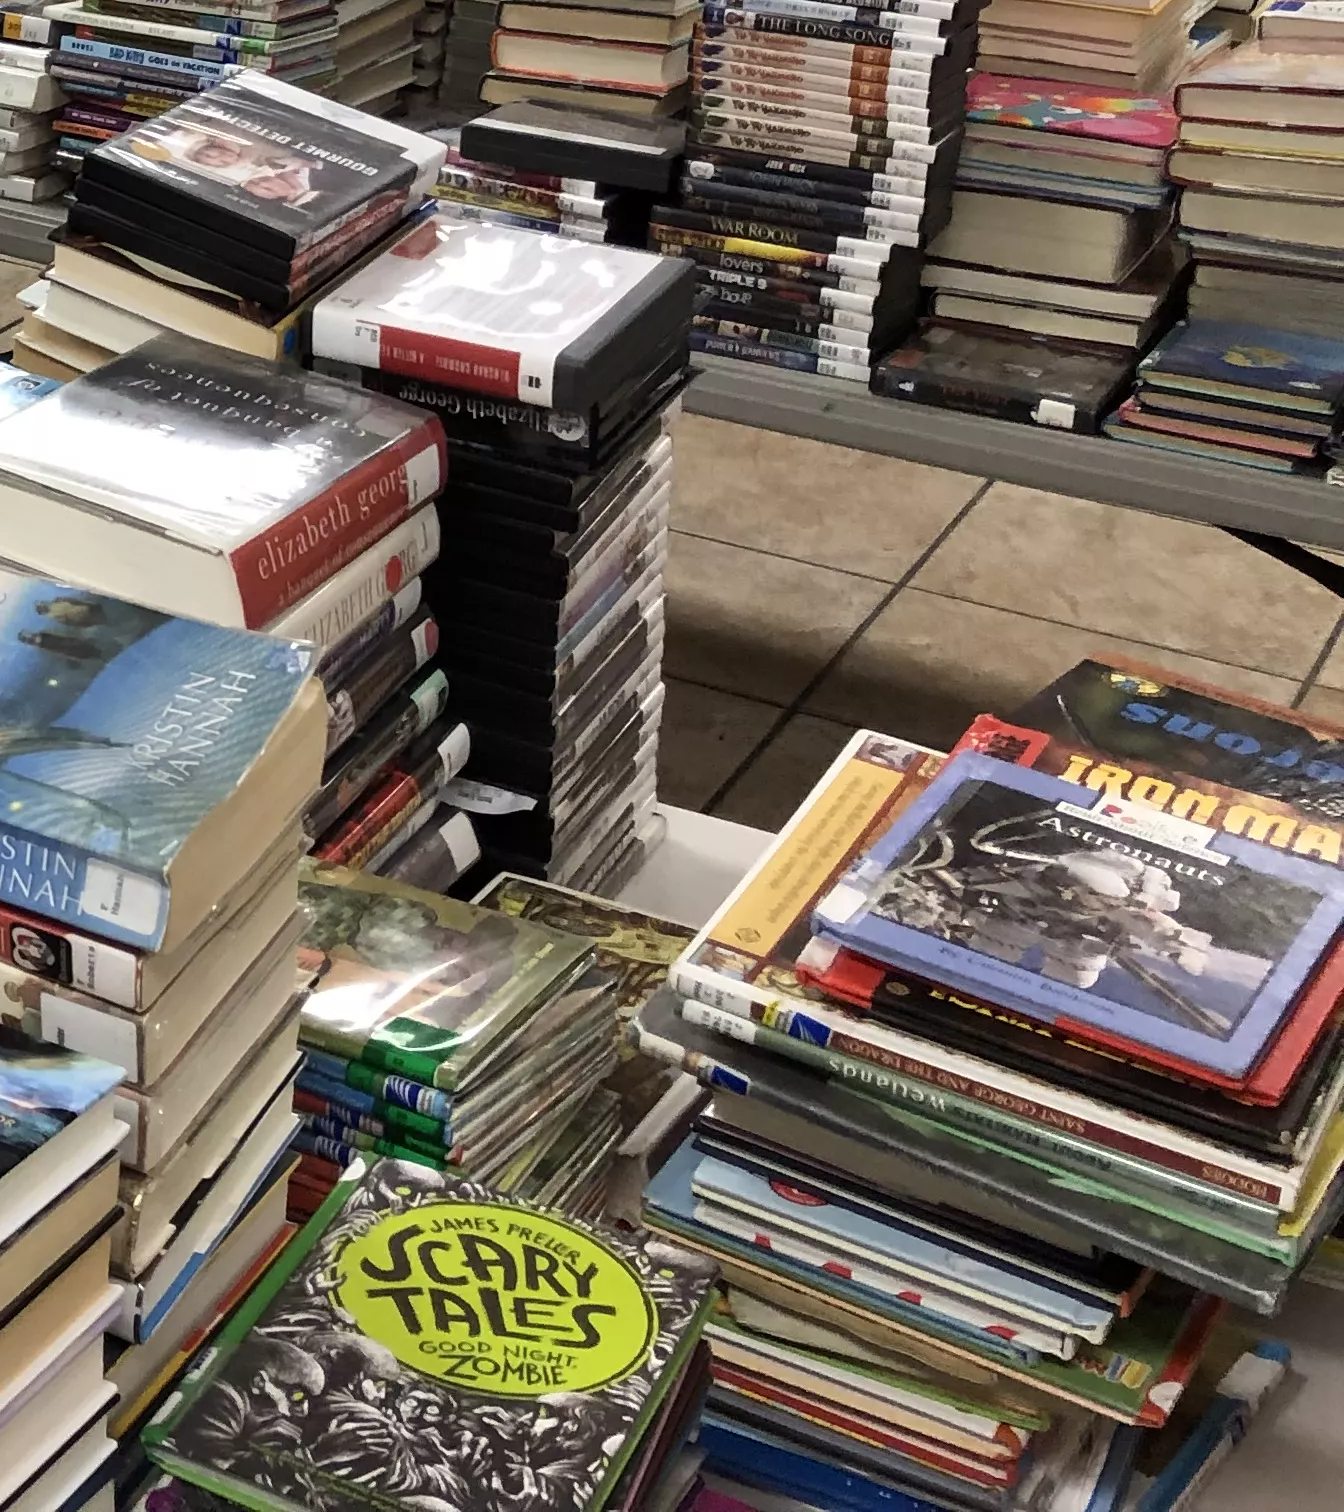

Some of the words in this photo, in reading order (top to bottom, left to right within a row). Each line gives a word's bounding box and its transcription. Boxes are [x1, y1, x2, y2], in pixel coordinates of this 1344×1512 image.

[760, 14, 792, 32] THE
[796, 18, 839, 38] LONG
[844, 27, 890, 46] SONG
[148, 55, 169, 65] GOES
[182, 62, 221, 76] VACATION
[290, 143, 379, 177] GOURMET
[713, 217, 744, 237] WAR
[748, 222, 800, 247] ROOM
[709, 269, 754, 288] TRIPLE
[720, 253, 764, 274] lovers
[144, 360, 368, 439] consequences
[167, 391, 303, 440] banquet
[398, 380, 462, 416] George
[257, 493, 352, 583] elizabeth
[357, 462, 409, 521] georg
[126, 671, 216, 771] KRISTIN
[148, 669, 258, 788] HANNAH
[1057, 754, 1222, 828] IRON
[1038, 815, 1228, 887] Astronauts
[828, 1058, 949, 1114] Wetlands
[974, 1082, 1041, 1120] GEORGE
[1045, 1108, 1087, 1134] SAINT
[1200, 1163, 1270, 1199] HODGES
[427, 1215, 501, 1237] JAMES
[359, 1222, 601, 1301] SCARY
[365, 1286, 618, 1350] TALES
[417, 1338, 492, 1358] GOOD
[440, 1353, 571, 1388] ZOMBIE
